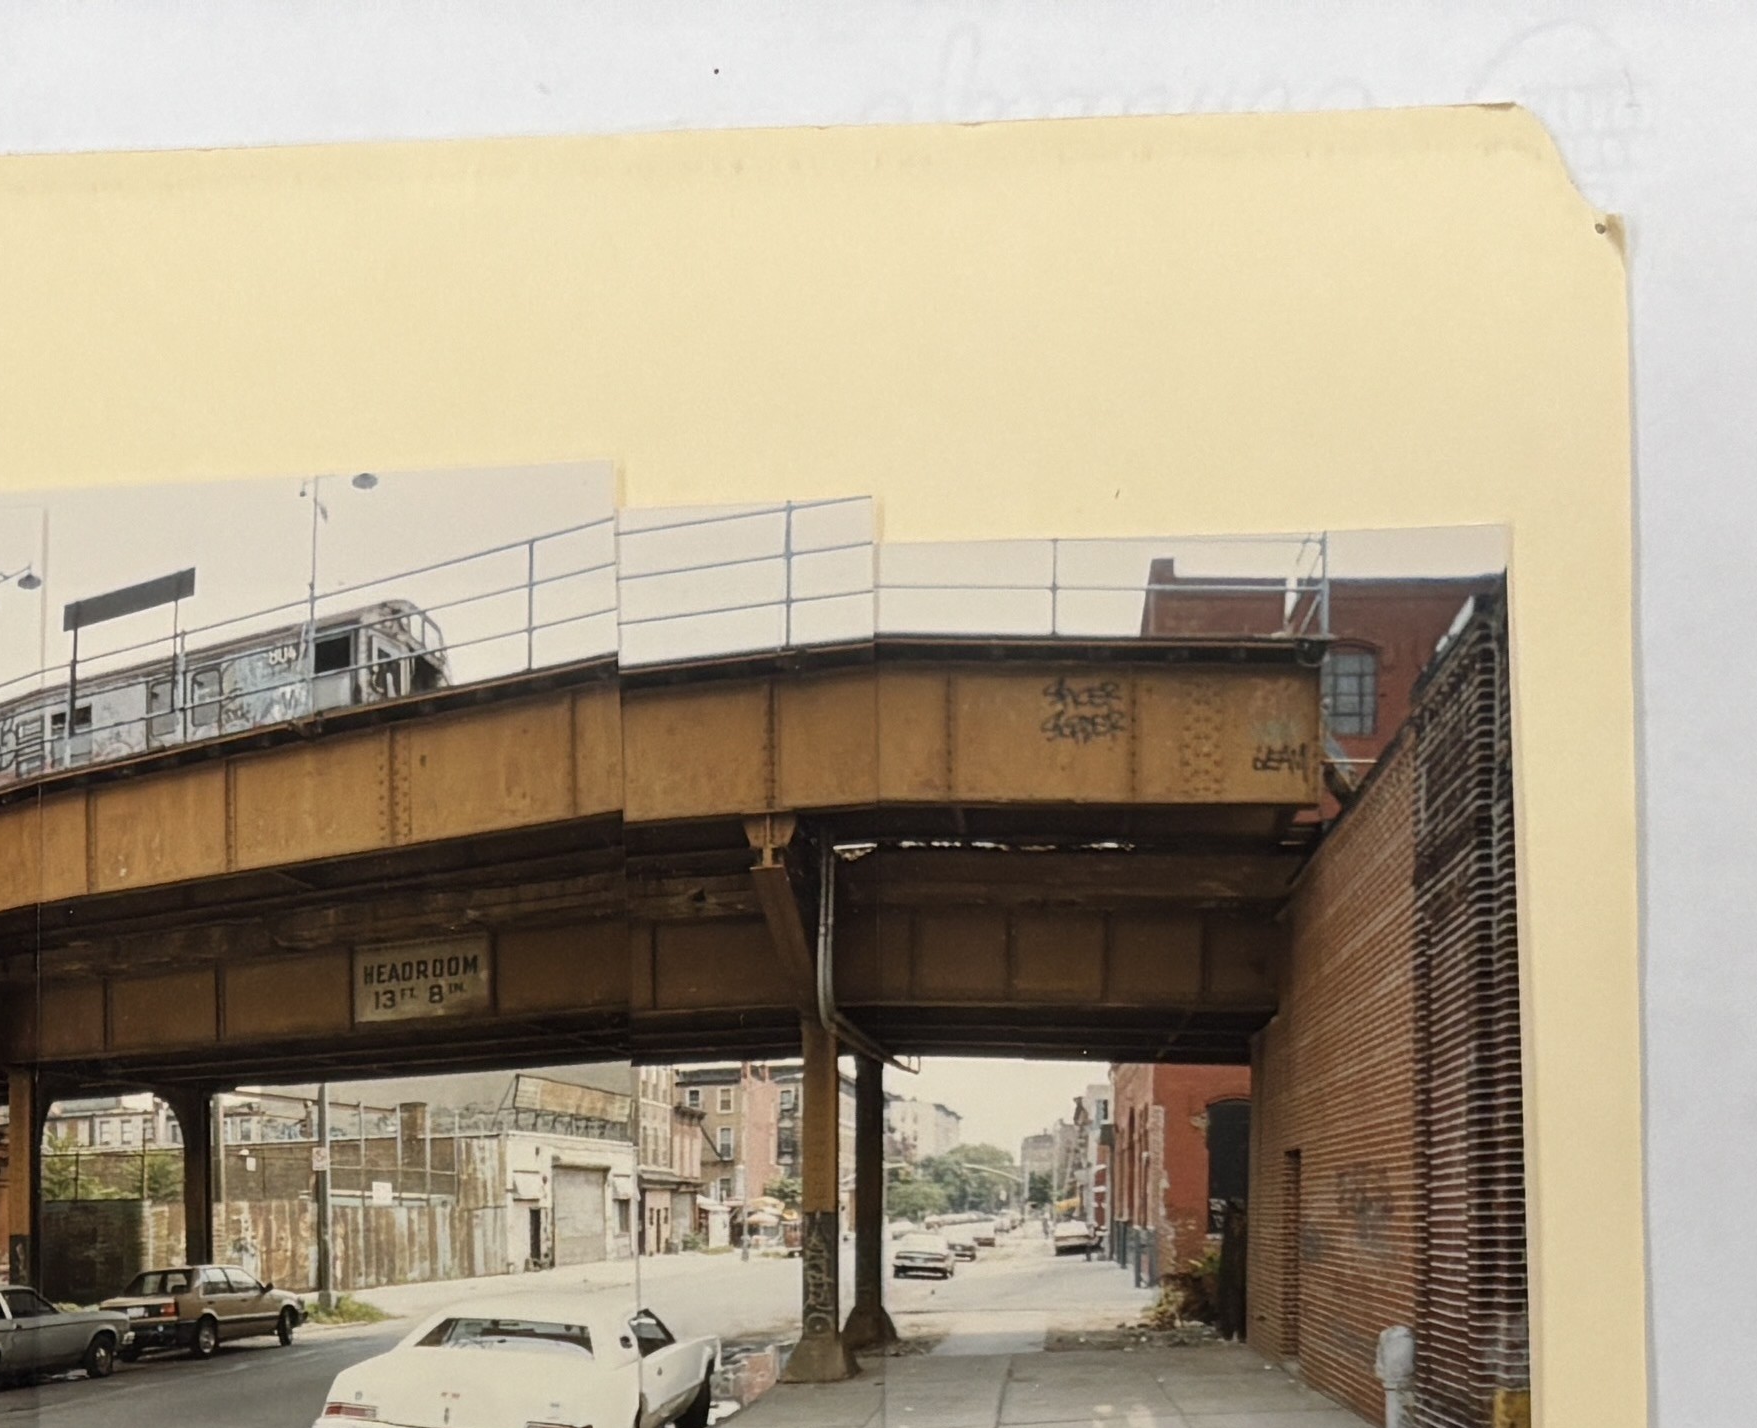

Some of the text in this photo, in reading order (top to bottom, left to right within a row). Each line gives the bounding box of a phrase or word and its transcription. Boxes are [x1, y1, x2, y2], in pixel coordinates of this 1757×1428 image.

[363, 954, 479, 986] HEADROOM
[374, 988, 396, 1010] 13
[428, 983, 444, 1004] 8
